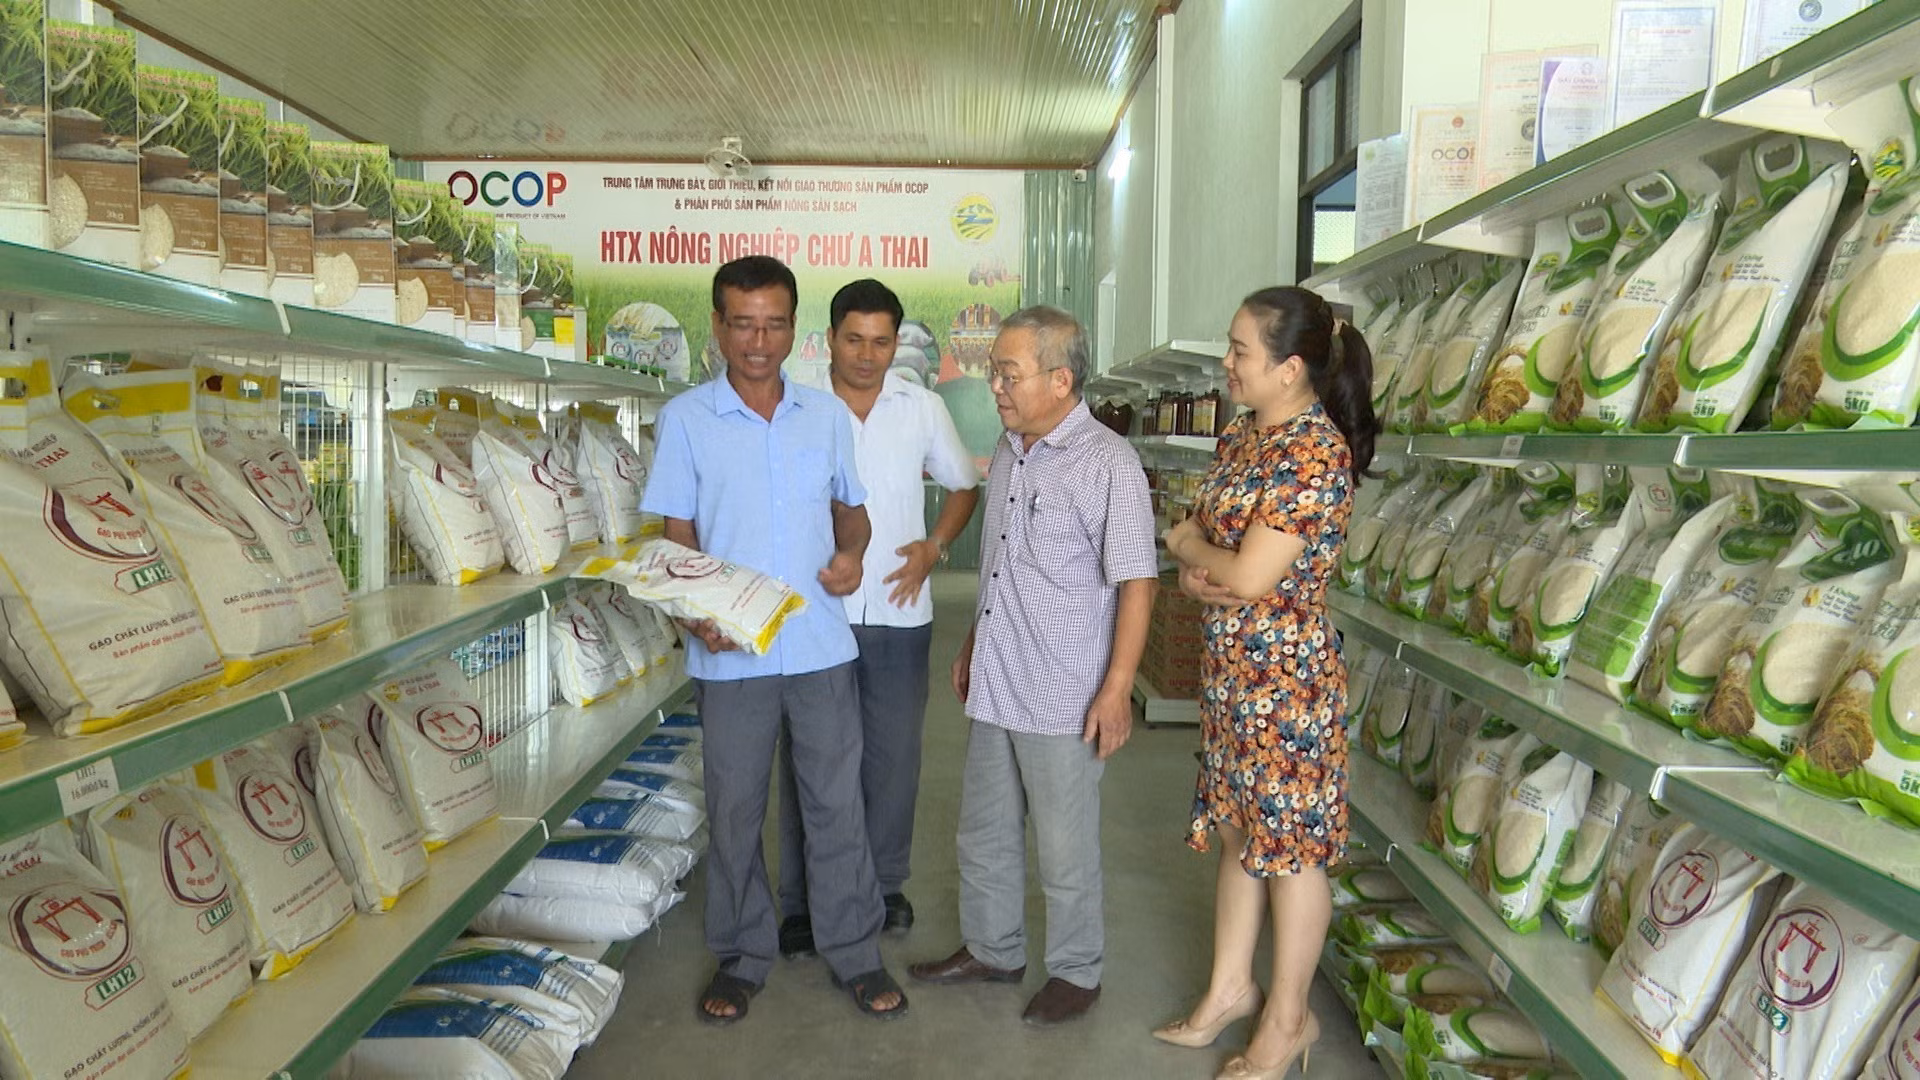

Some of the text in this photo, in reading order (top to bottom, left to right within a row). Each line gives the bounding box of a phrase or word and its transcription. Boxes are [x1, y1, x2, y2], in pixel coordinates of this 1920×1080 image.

[447, 171, 567, 207] OCOP
[602, 176, 929, 194] TRUNG TÂM TRƯNG BÀY, GIỚI THIỆU, KẾT NỐI GIAO THƯƠNG SẢN PHẨM OCOP
[674, 195, 857, 214] & PHÂN PHỐI SẢN PHẨM NÔNG SẢN SẠCH
[600, 225, 929, 269] HTX NÔNG NGHIỆP CHƯ A THAI
[134, 564, 172, 587] LH12
[88, 636, 112, 652] GẠO
[114, 627, 140, 643] CHẤT
[98, 966, 135, 1000] LH12
[64, 1062, 85, 1080] GẠO
